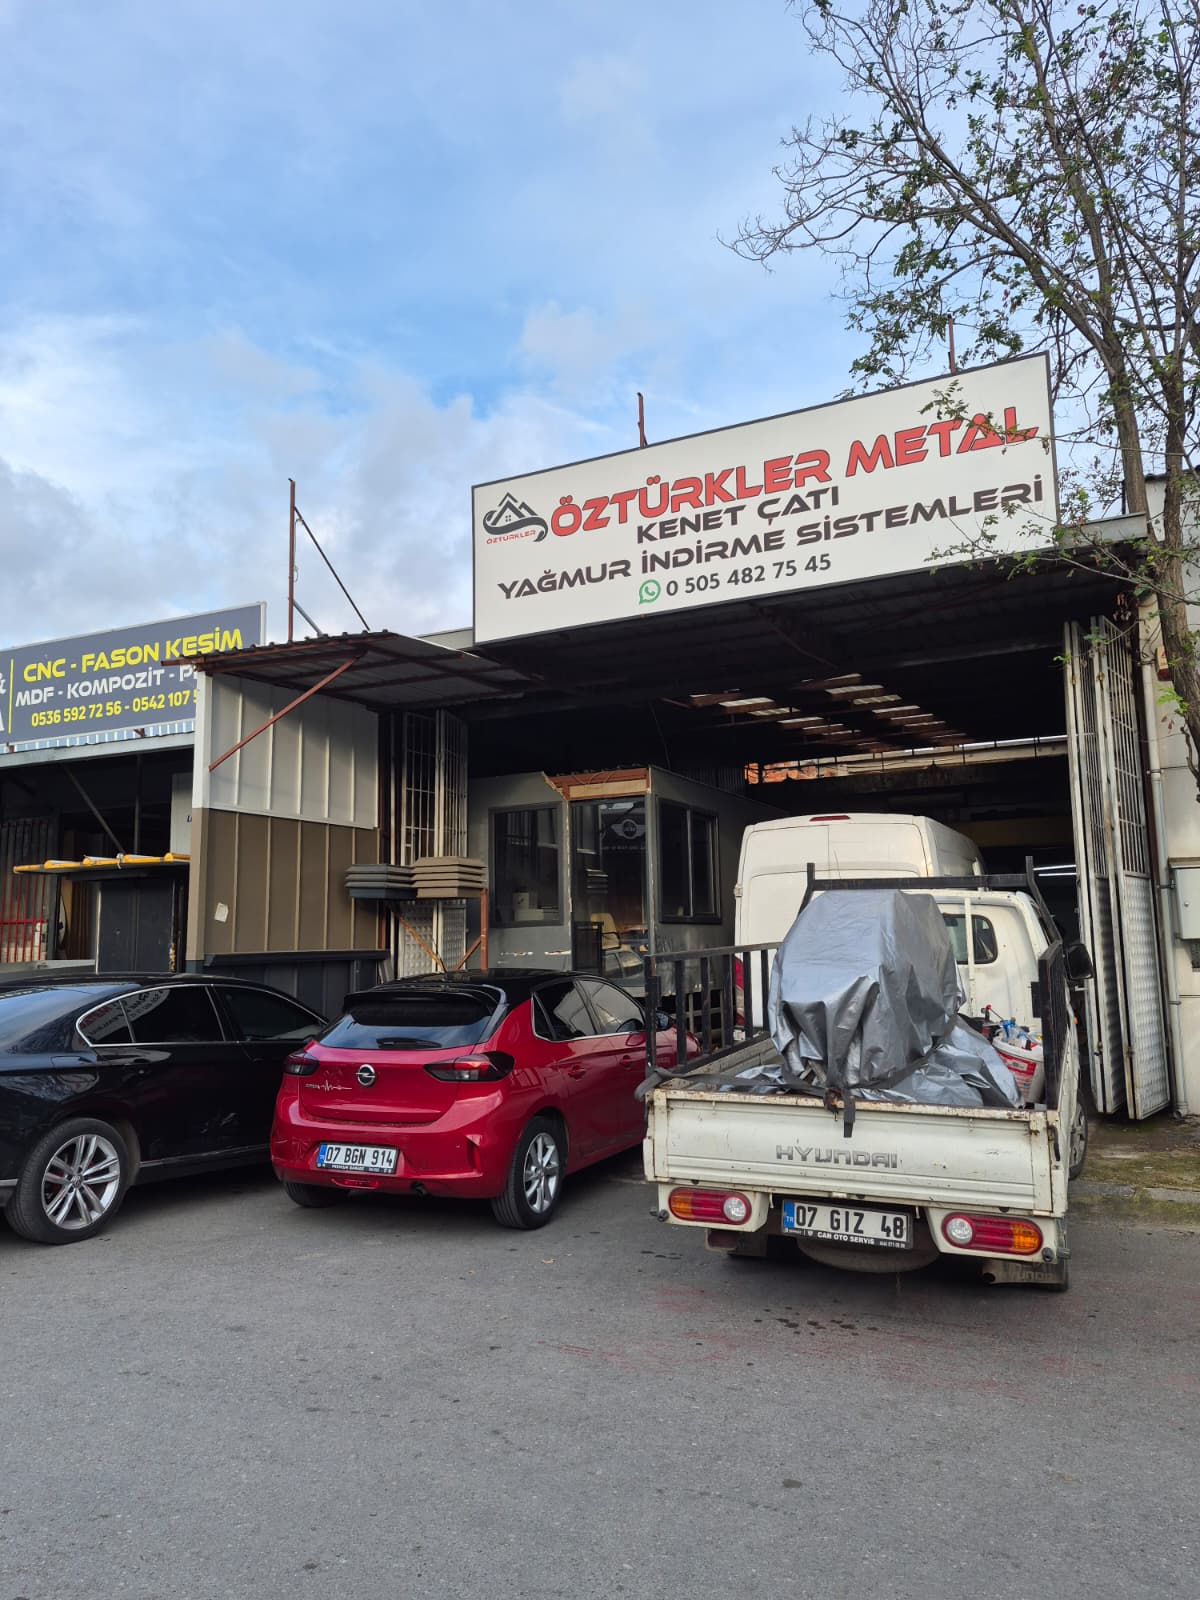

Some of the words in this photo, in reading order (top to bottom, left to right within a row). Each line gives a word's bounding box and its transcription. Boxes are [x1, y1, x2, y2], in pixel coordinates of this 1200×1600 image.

[551, 449, 832, 537] ÖZTÜRKLER
[846, 407, 1039, 477] METAL
[637, 504, 746, 544] KENET
[757, 486, 839, 533] ÇATI
[498, 558, 632, 600] YAĞMUR
[641, 529, 785, 574] İNDİRME
[797, 474, 1043, 545] SİSTEMLERİ
[667, 579, 678, 597] 0
[685, 571, 720, 593] 505
[728, 564, 766, 587] 482
[773, 560, 797, 581] 75
[804, 553, 832, 575] 45
[23, 658, 66, 682] CNC
[82, 642, 159, 673] FASON
[166, 627, 242, 658] KESİM
[16, 687, 54, 707] MDF
[67, 667, 164, 699] KOMPOZİT
[179, 664, 198, 681] P
[32, 709, 60, 727] 0536
[64, 706, 85, 722] 592
[89, 703, 102, 719] 72
[106, 699, 121, 715] 56
[133, 695, 164, 712] 0542
[168, 690, 190, 707] 107
[326, 1147, 340, 1162] 07
[344, 1148, 366, 1164] BGN
[371, 1150, 392, 1167] 914
[776, 1144, 897, 1168] HYUNDAI
[796, 1206, 817, 1227] 07
[830, 1210, 864, 1234] GIZ
[881, 1216, 904, 1239] 48
